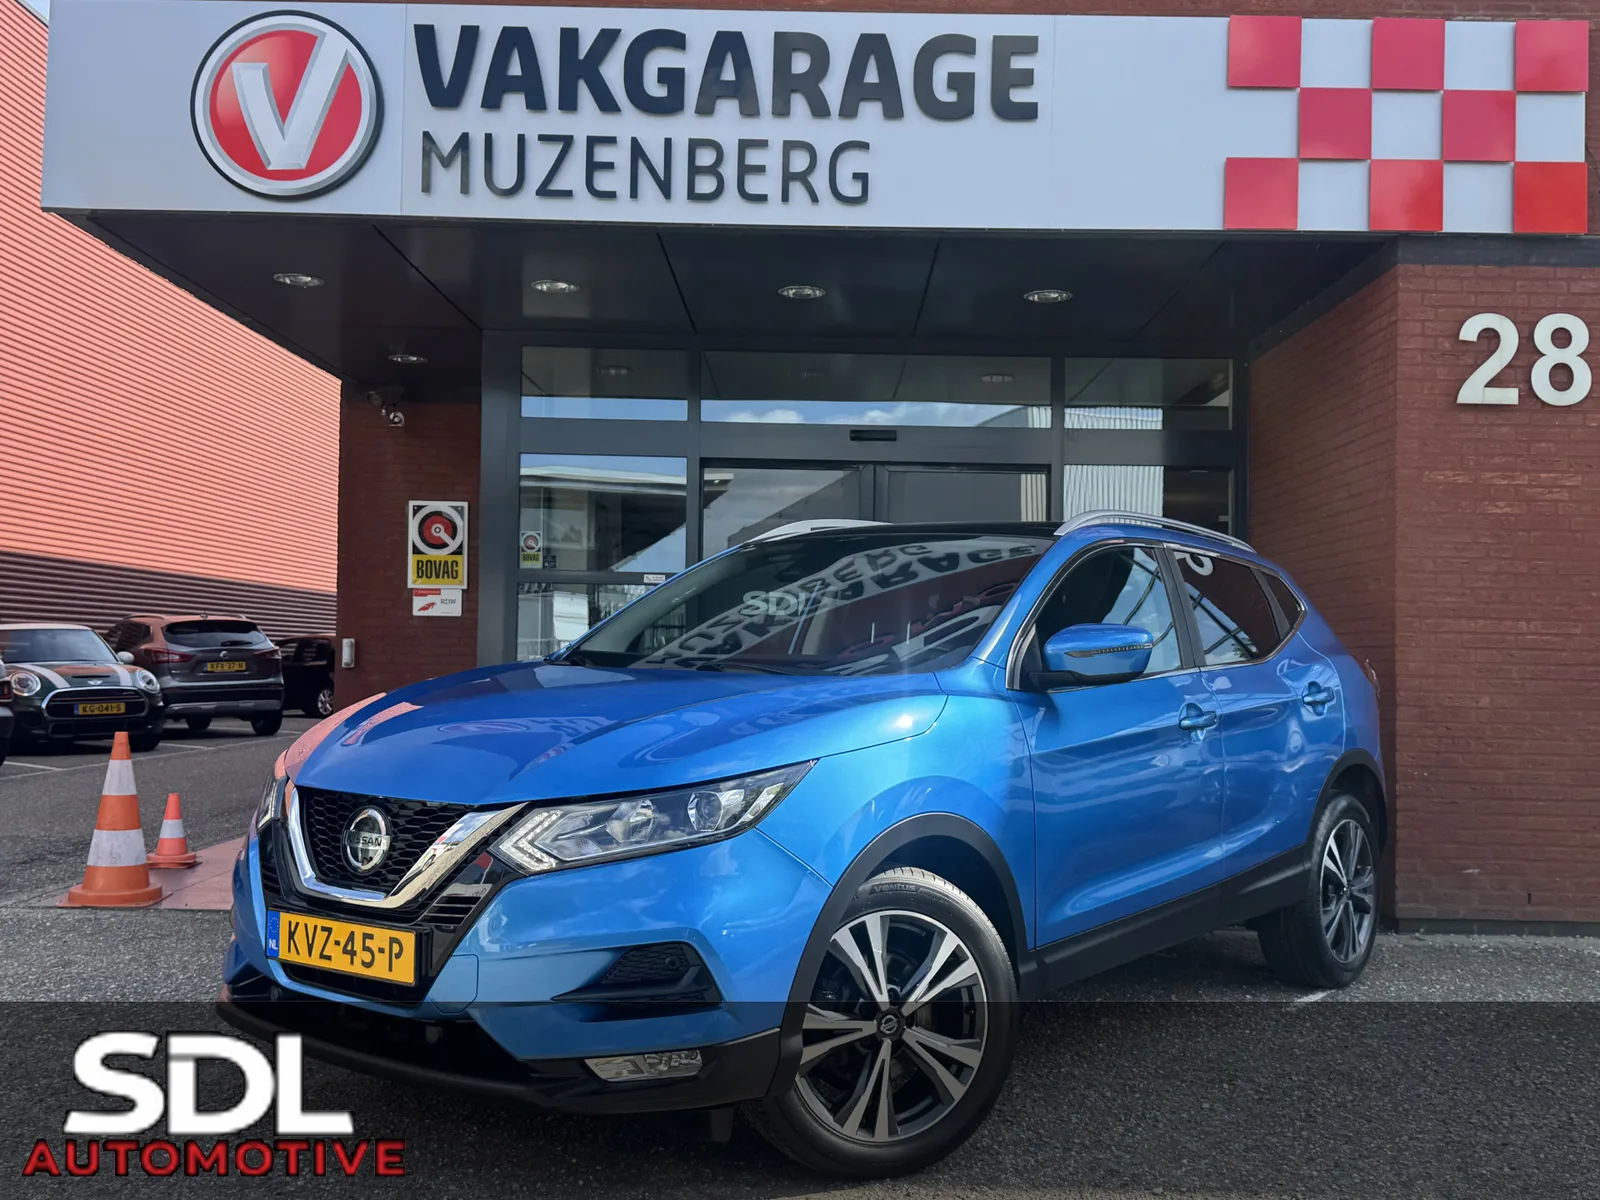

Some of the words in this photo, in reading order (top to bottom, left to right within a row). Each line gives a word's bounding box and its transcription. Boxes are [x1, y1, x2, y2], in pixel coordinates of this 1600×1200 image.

[413, 24, 1039, 121] VAKGARAGE
[421, 130, 870, 204] MUZENBERG
[1456, 312, 1593, 407] 28
[416, 559, 459, 580] BOVAG
[82, 703, 121, 713] KG-041-S
[268, 938, 279, 950] NL
[287, 920, 404, 972] KVZ-45-P
